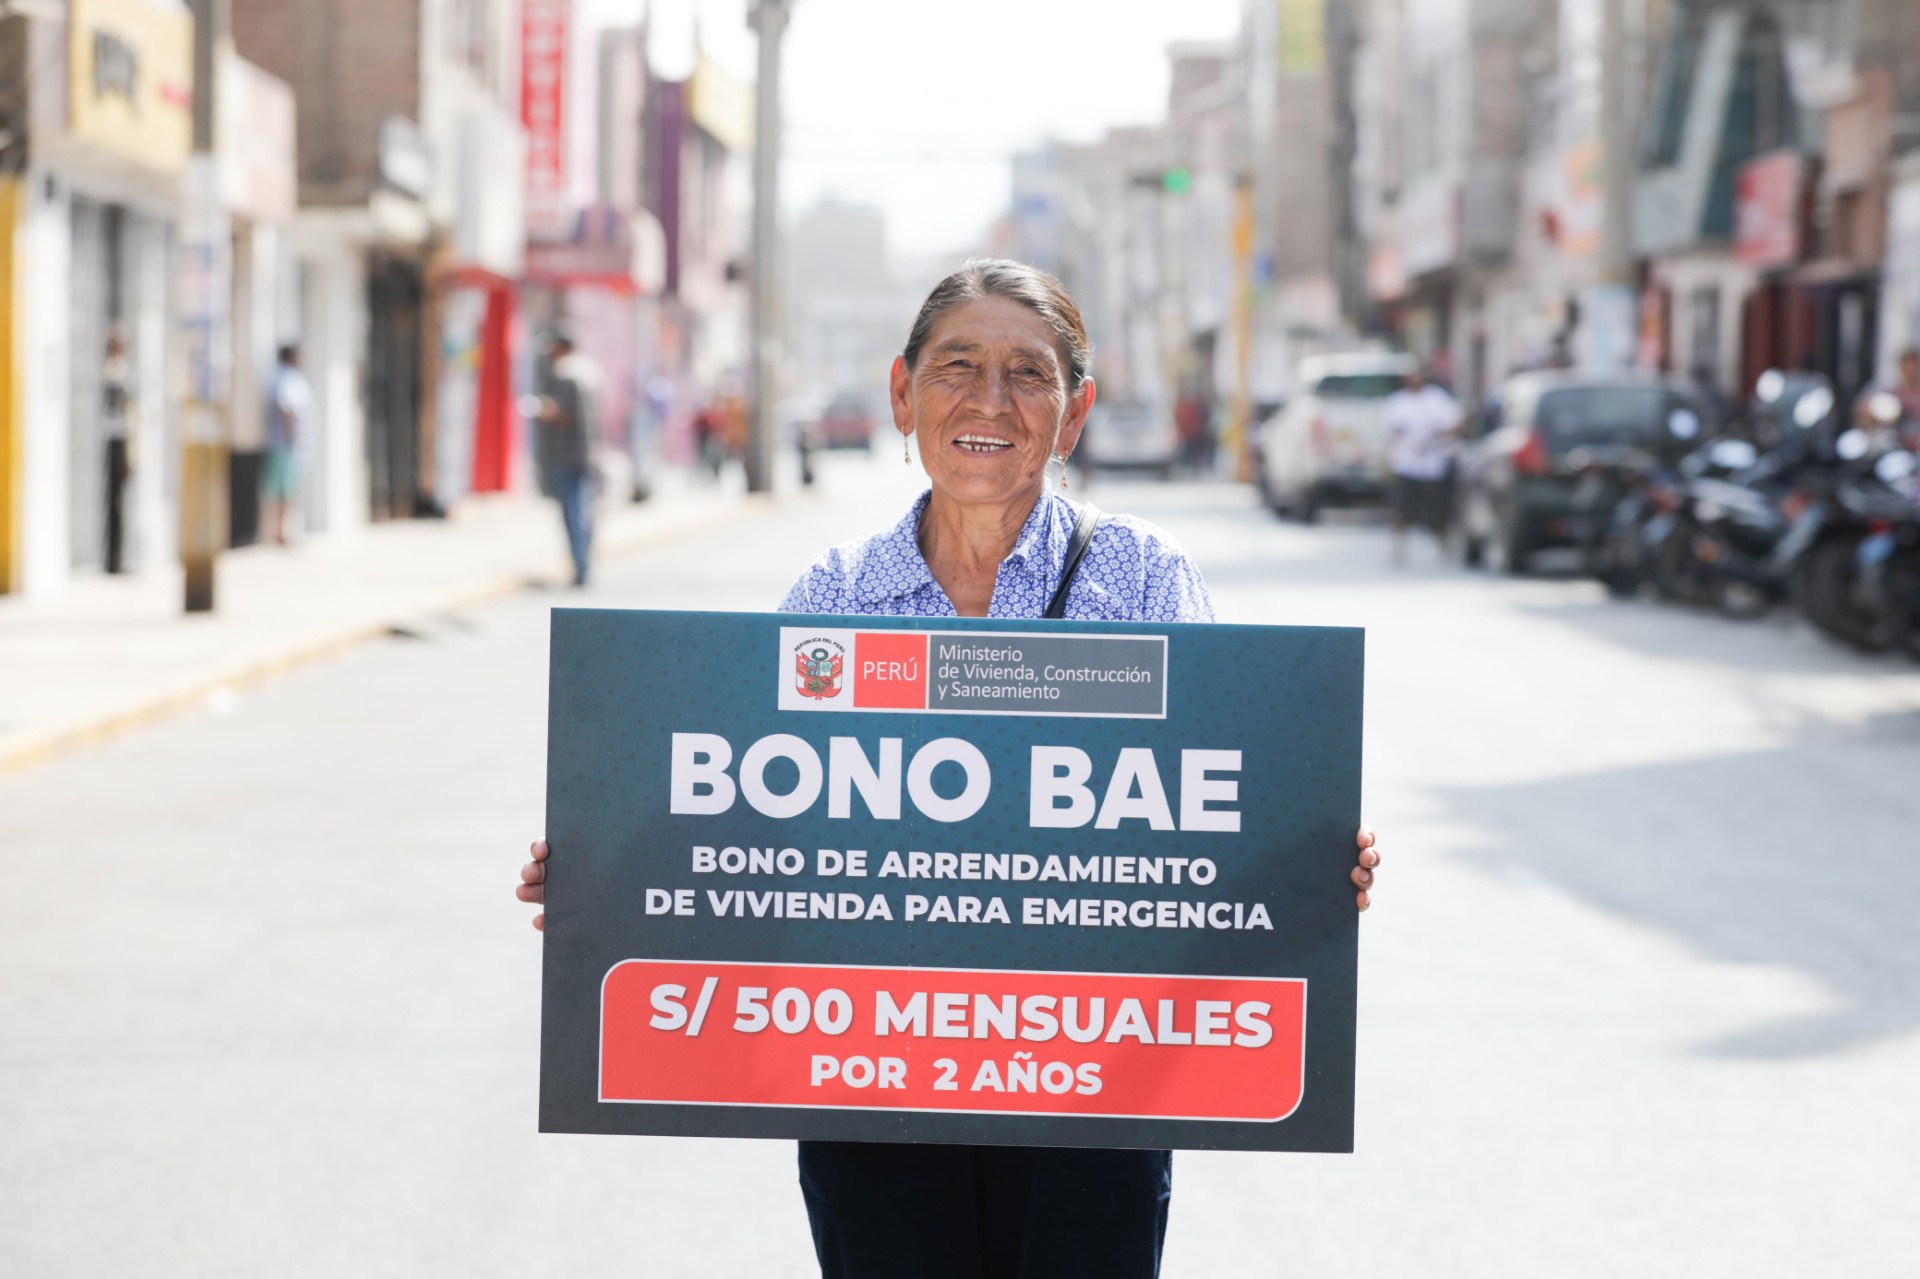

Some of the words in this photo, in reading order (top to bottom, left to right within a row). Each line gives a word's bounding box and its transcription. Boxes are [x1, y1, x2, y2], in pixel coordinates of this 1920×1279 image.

[822, 637, 832, 645] DEL
[939, 645, 1023, 662] Ministerio
[863, 657, 918, 681] PERÚ
[938, 663, 960, 679] de
[963, 664, 1039, 682] Vivienda,
[1043, 665, 1151, 683] Construcción
[938, 684, 948, 700] y
[951, 682, 1060, 700] Saneamiento
[670, 732, 991, 823] BONO
[1029, 745, 1242, 833] BAE
[692, 846, 805, 876] BONO
[817, 849, 868, 877] DE
[878, 851, 1217, 886] ARRENDAMIENTO
[645, 888, 696, 916] DE
[706, 889, 894, 921] VIVIENDA
[904, 894, 1011, 924] PARA
[1022, 897, 1274, 930] EMERGENCIA
[649, 976, 719, 1036] S/
[732, 986, 853, 1035] 500
[874, 991, 1274, 1047] MENSUALES
[810, 1054, 907, 1090] POR
[932, 1057, 959, 1091] 2
[970, 1050, 1103, 1096] AÑOS
